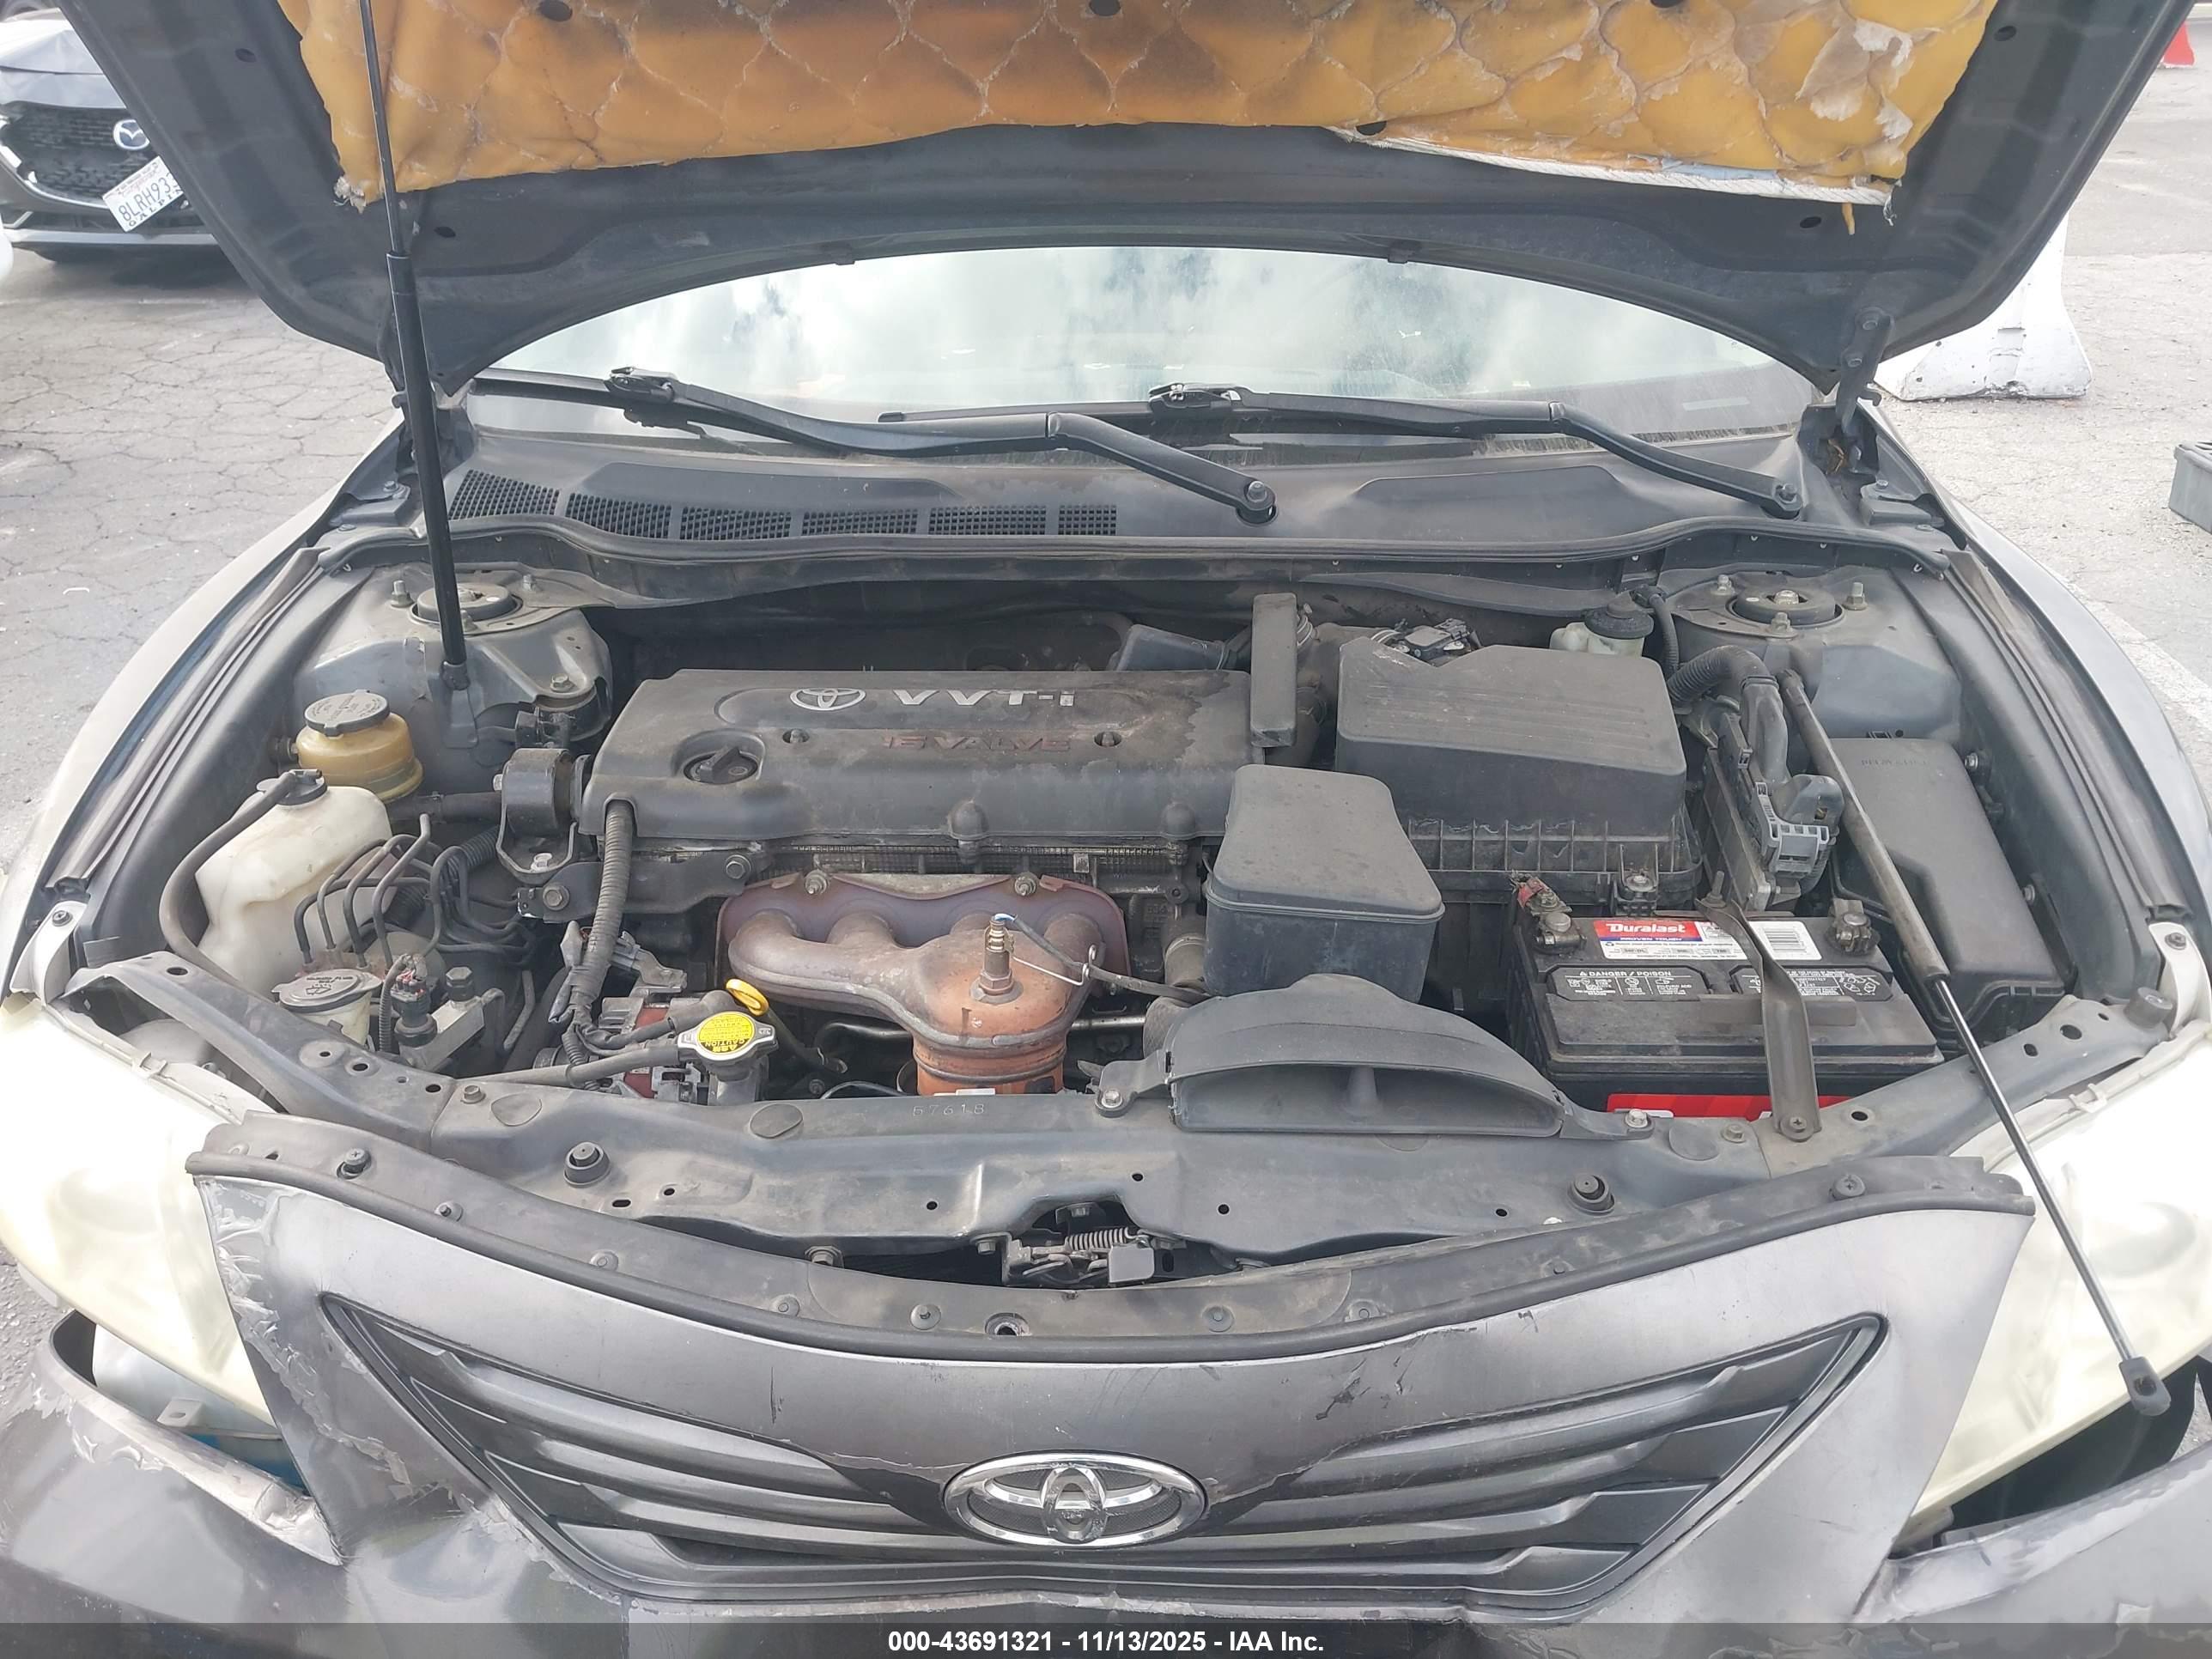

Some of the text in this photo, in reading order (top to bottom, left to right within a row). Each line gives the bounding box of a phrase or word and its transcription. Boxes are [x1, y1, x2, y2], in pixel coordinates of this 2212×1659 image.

[933, 735, 1071, 751] VALVE
[1606, 923, 1686, 933] Duralast
[705, 1038, 744, 1047] CAUTION
